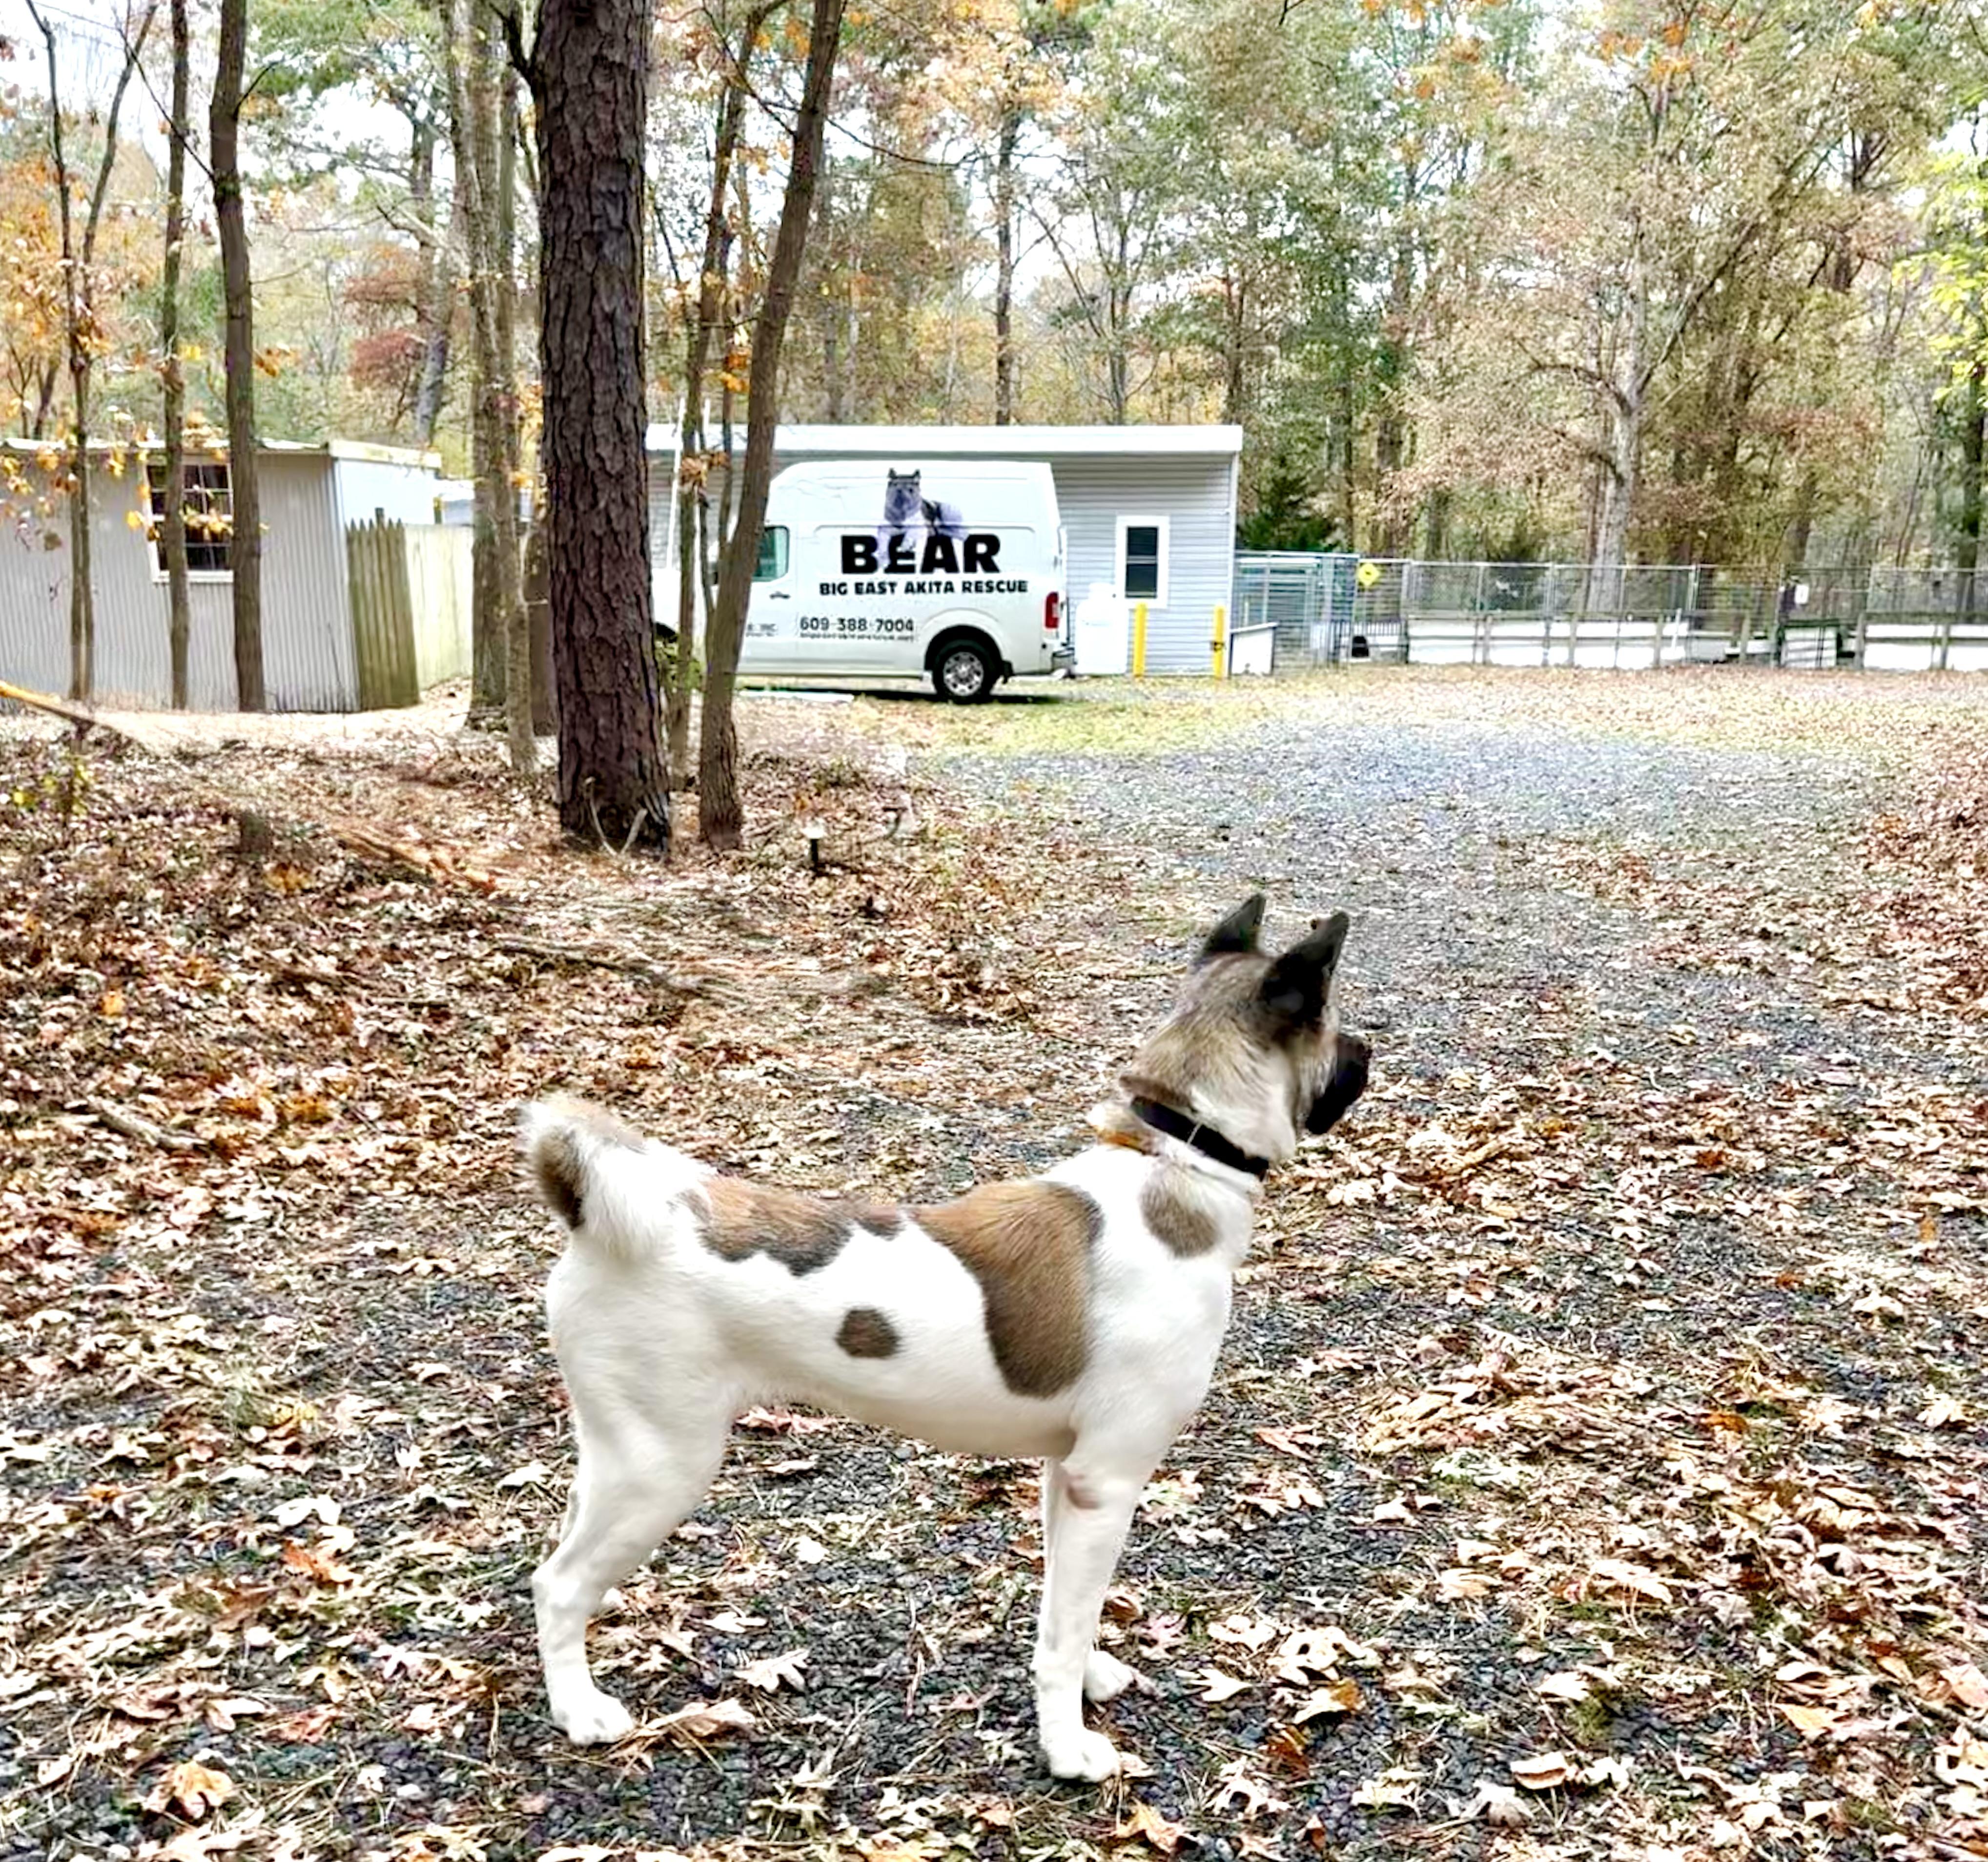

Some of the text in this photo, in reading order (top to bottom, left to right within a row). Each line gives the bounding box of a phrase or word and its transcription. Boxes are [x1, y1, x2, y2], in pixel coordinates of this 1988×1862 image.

[840, 534, 1000, 574] BEAR
[820, 579, 1028, 596] BIG EAST AKITA RESCUE
